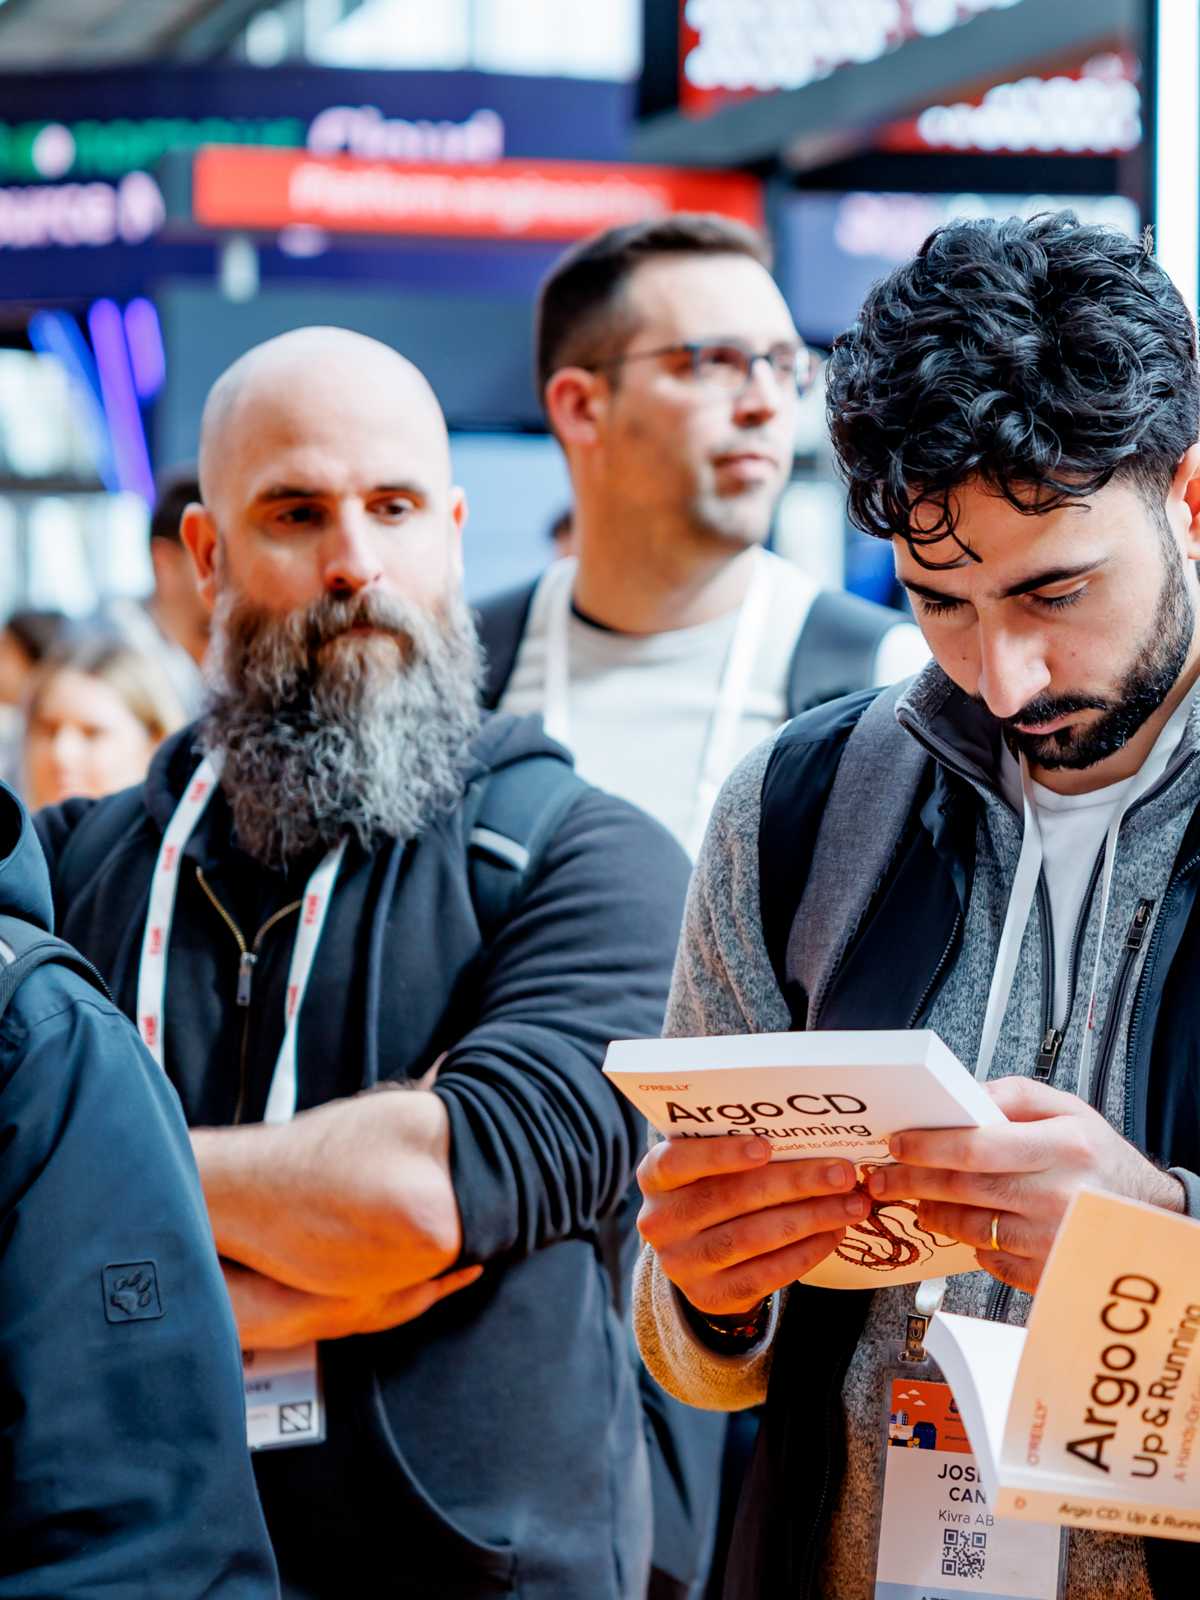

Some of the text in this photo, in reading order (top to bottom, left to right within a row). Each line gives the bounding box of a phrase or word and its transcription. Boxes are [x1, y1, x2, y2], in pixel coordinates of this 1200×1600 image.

[665, 1094, 867, 1126] Argo CD
[750, 1123, 872, 1138] Running
[771, 1143, 807, 1152] Guide
[823, 1139, 864, 1149] GitOps
[866, 1137, 888, 1146] and
[1066, 1272, 1162, 1474] Argo CD
[1141, 1407, 1171, 1427] &
[1131, 1433, 1169, 1478] Up
[938, 1509, 995, 1527] Kivra AB
[1058, 1502, 1092, 1518] Argo
[1096, 1505, 1122, 1521] CD:
[1127, 1509, 1147, 1526] Up
[1150, 1513, 1160, 1526] &
